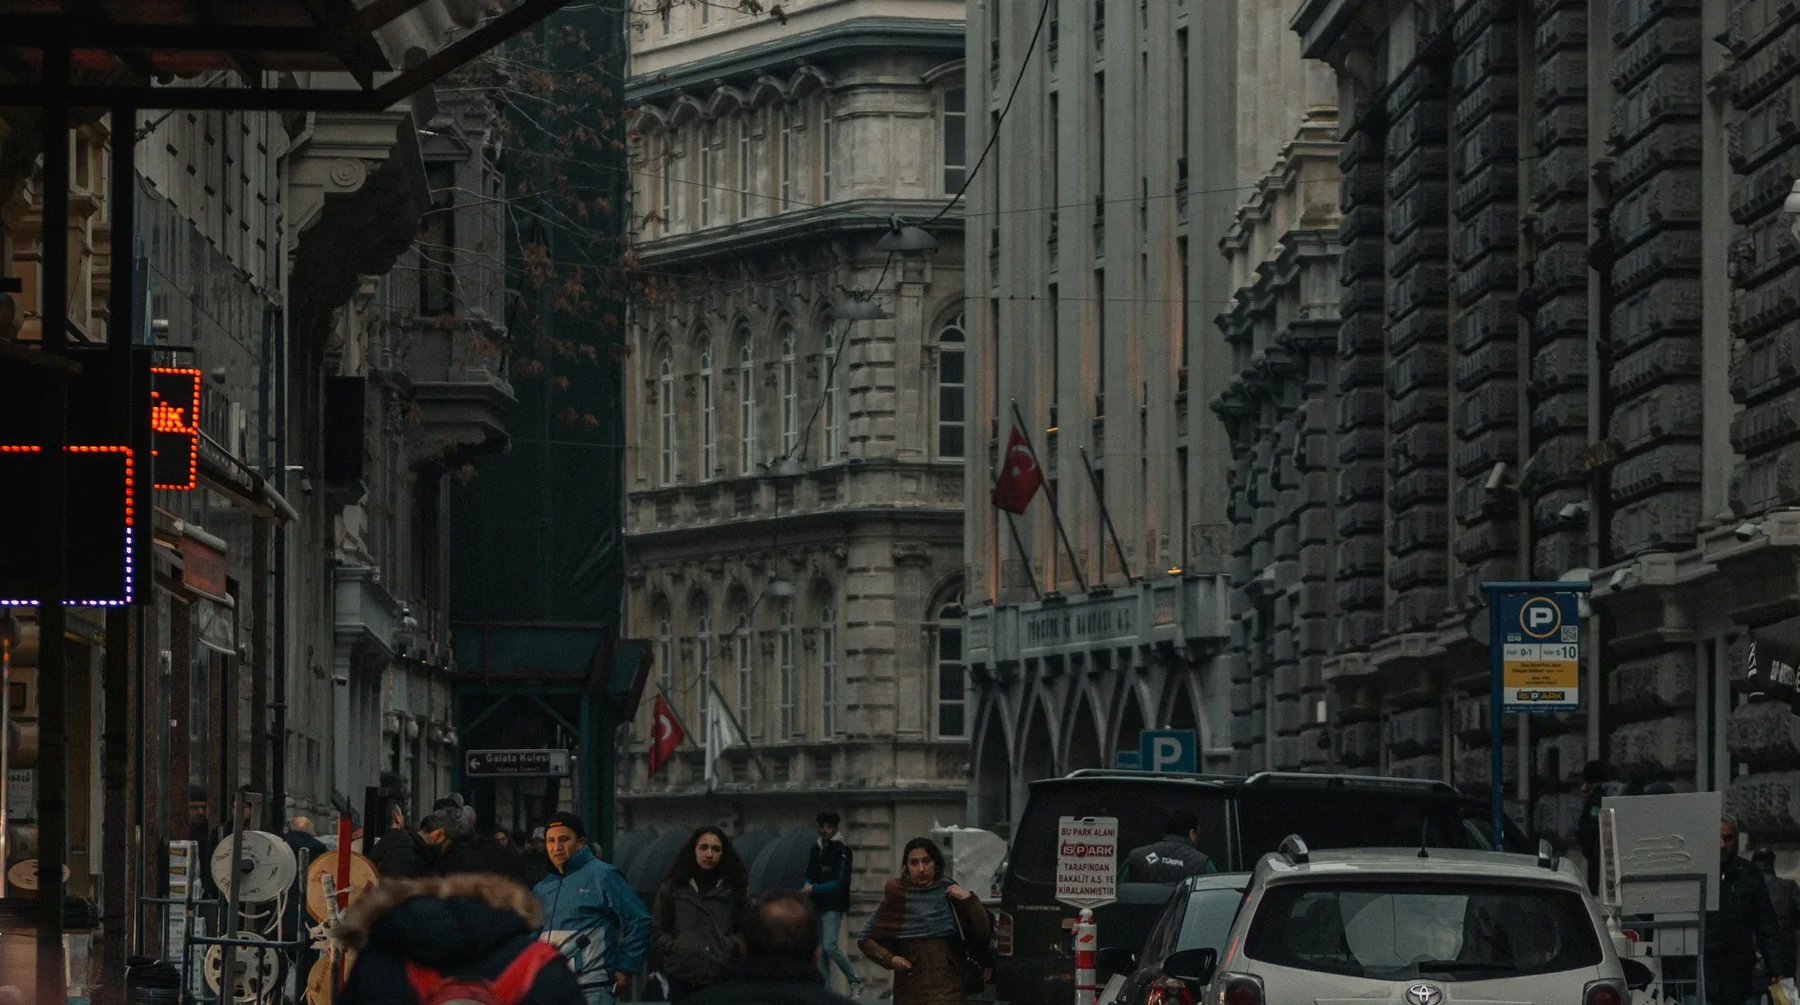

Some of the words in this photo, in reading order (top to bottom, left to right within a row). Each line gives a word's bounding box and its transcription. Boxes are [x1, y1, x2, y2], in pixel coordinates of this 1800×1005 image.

[1530, 607, 1553, 628] P
[486, 753, 517, 762] Galata
[520, 753, 549, 762] Kulesi
[1153, 737, 1183, 773] P
[1061, 827, 1072, 836] BU
[1073, 828, 1093, 836] PARK
[1094, 828, 1115, 837] ALANI
[1064, 863, 1110, 872] TARAFINDAN
[1105, 875, 1115, 884] YE
